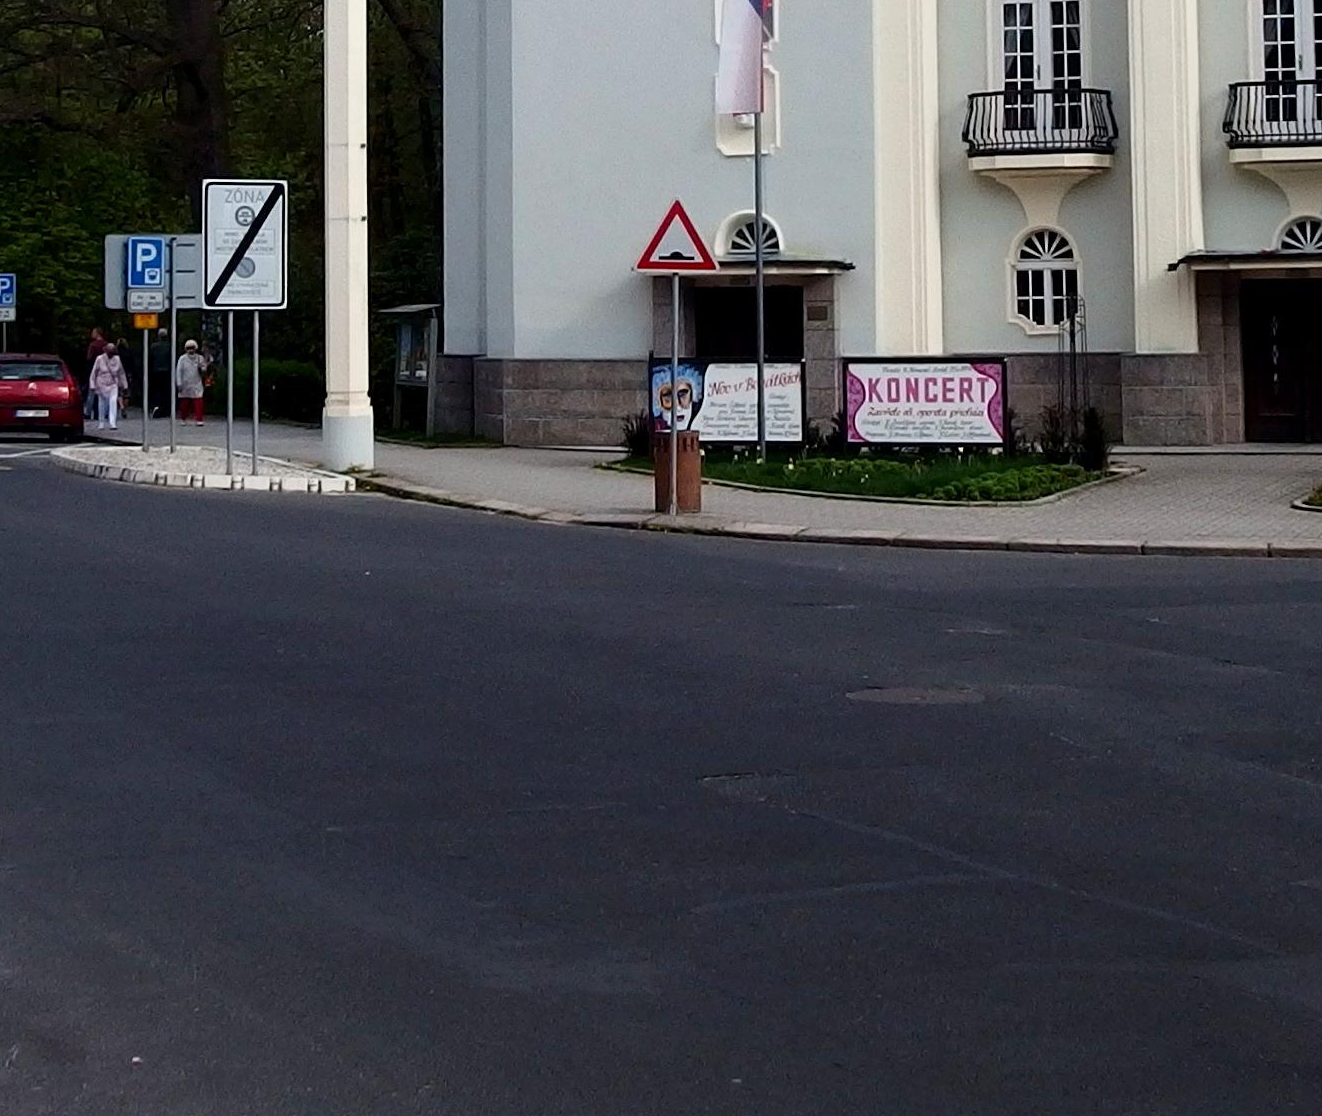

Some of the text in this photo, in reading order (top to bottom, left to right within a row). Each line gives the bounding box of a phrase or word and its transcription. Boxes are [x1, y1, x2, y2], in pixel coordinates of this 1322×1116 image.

[225, 187, 265, 204] ZÓNA
[136, 243, 157, 272] P
[868, 377, 990, 403] KONCERT
